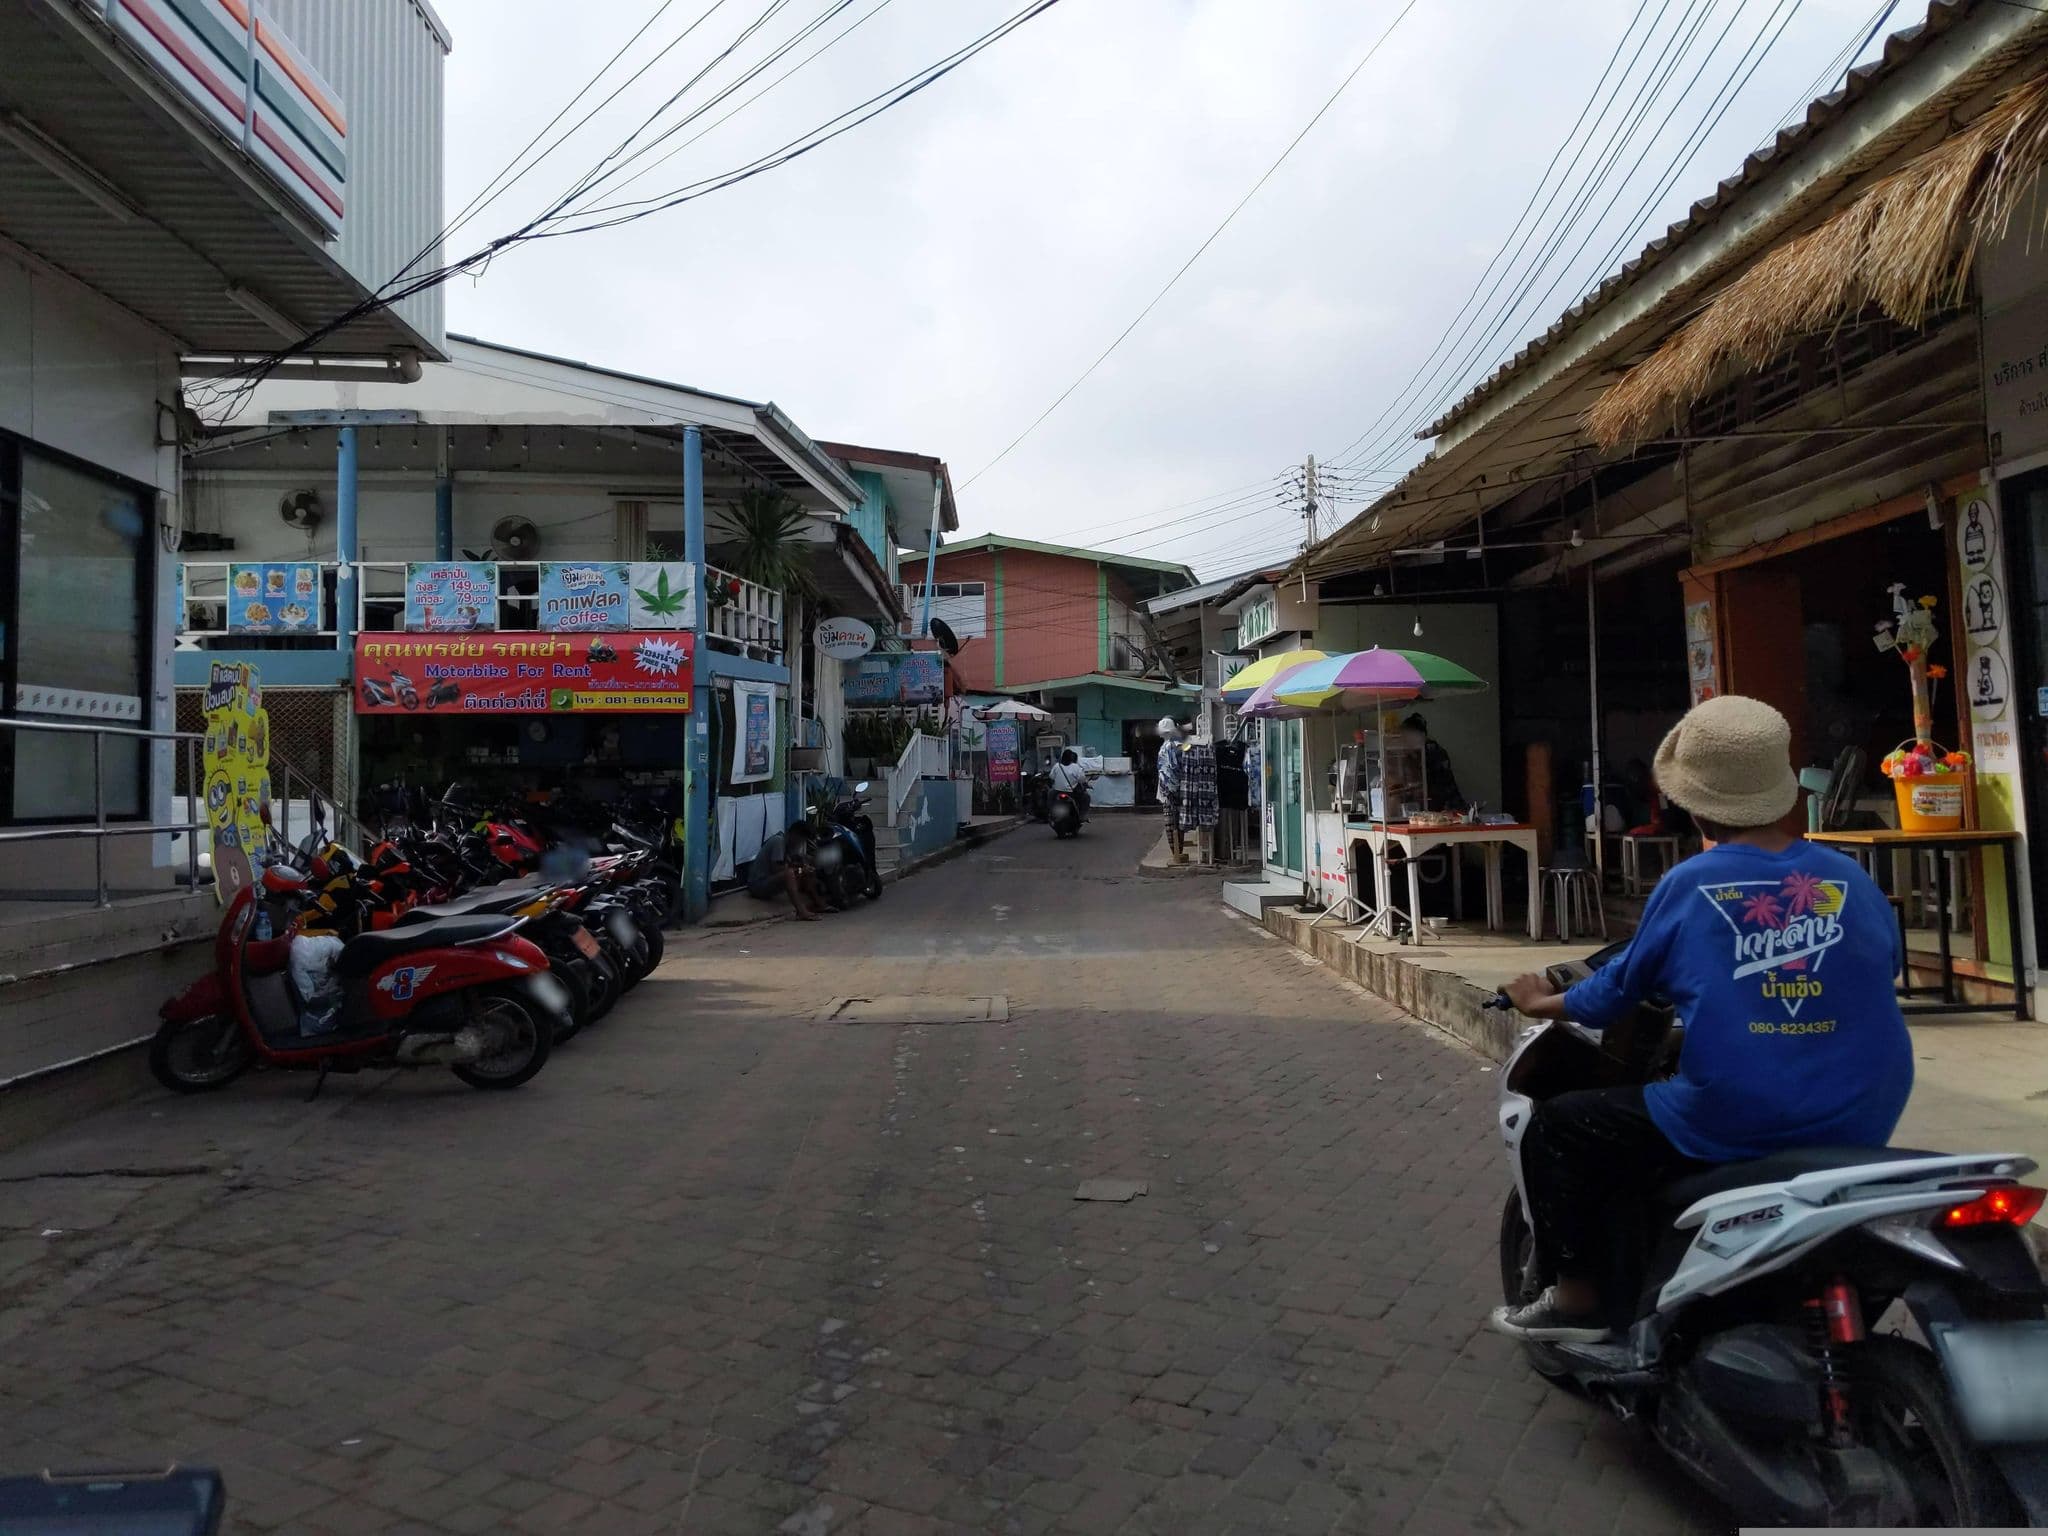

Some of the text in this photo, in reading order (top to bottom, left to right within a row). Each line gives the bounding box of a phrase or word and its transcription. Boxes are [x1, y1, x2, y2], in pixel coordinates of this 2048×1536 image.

[547, 590, 621, 612] กาแฟสด
[560, 611, 608, 626] coffee
[362, 634, 484, 664] คุณพรชัย
[424, 663, 592, 679] Motorbike For Rent
[463, 688, 547, 711] ติดต่อที่นี่
[1761, 971, 1823, 999] น้ำแข็ง
[1748, 1020, 1837, 1035] 080-8234357
